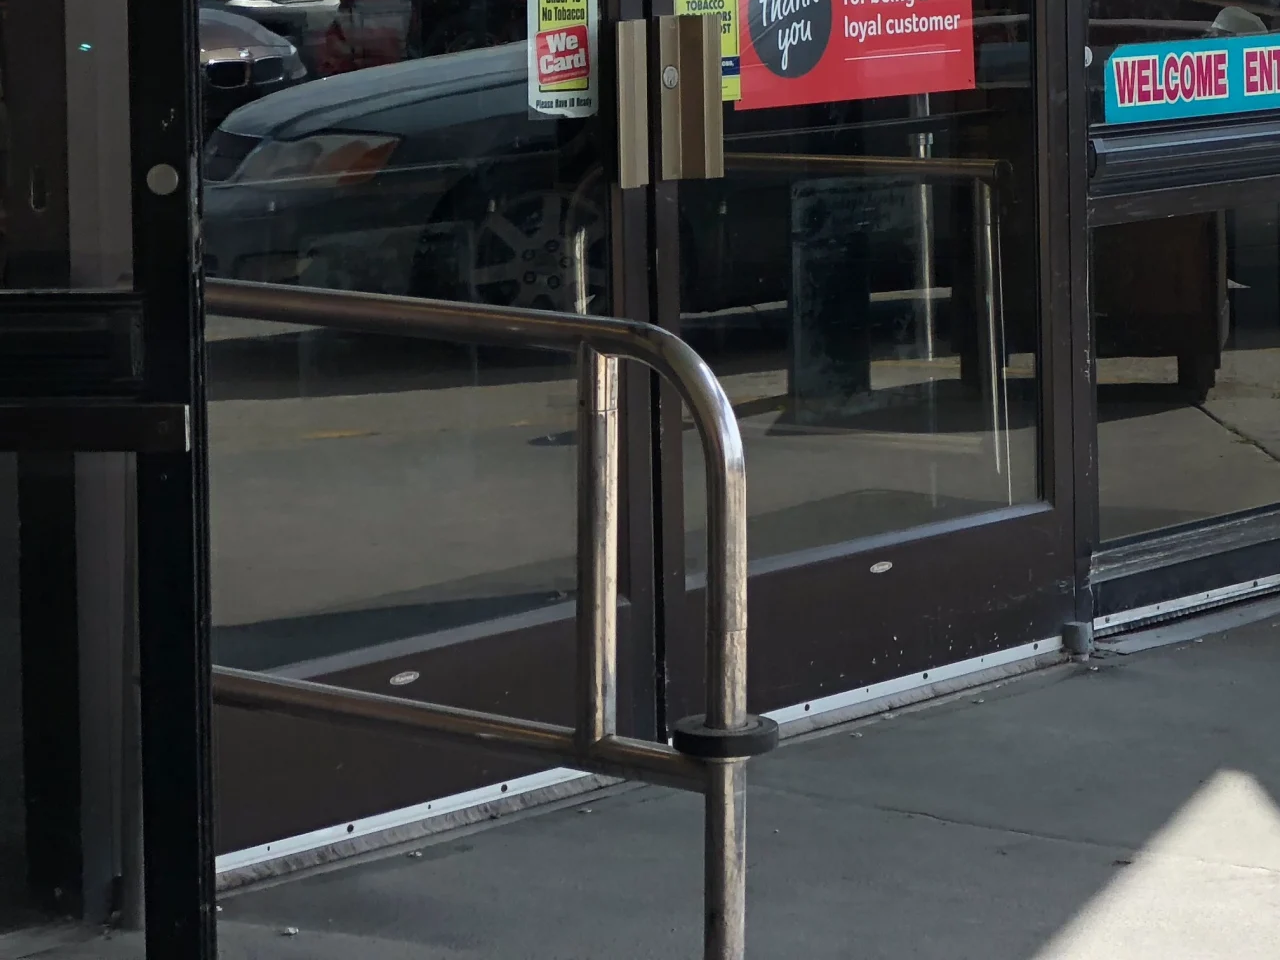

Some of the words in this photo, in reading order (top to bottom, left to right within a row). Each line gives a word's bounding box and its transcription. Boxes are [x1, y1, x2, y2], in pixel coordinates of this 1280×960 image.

[542, 8, 552, 22] No
[554, 7, 584, 20] Tobacco
[686, 0, 724, 12] TOBACCO
[844, 14, 882, 42] loyal
[886, 13, 960, 34] customer
[546, 32, 578, 54] We
[777, 19, 812, 70] you
[540, 49, 586, 74] Card
[1112, 50, 1228, 107] WELCOME
[536, 100, 553, 108] Please
